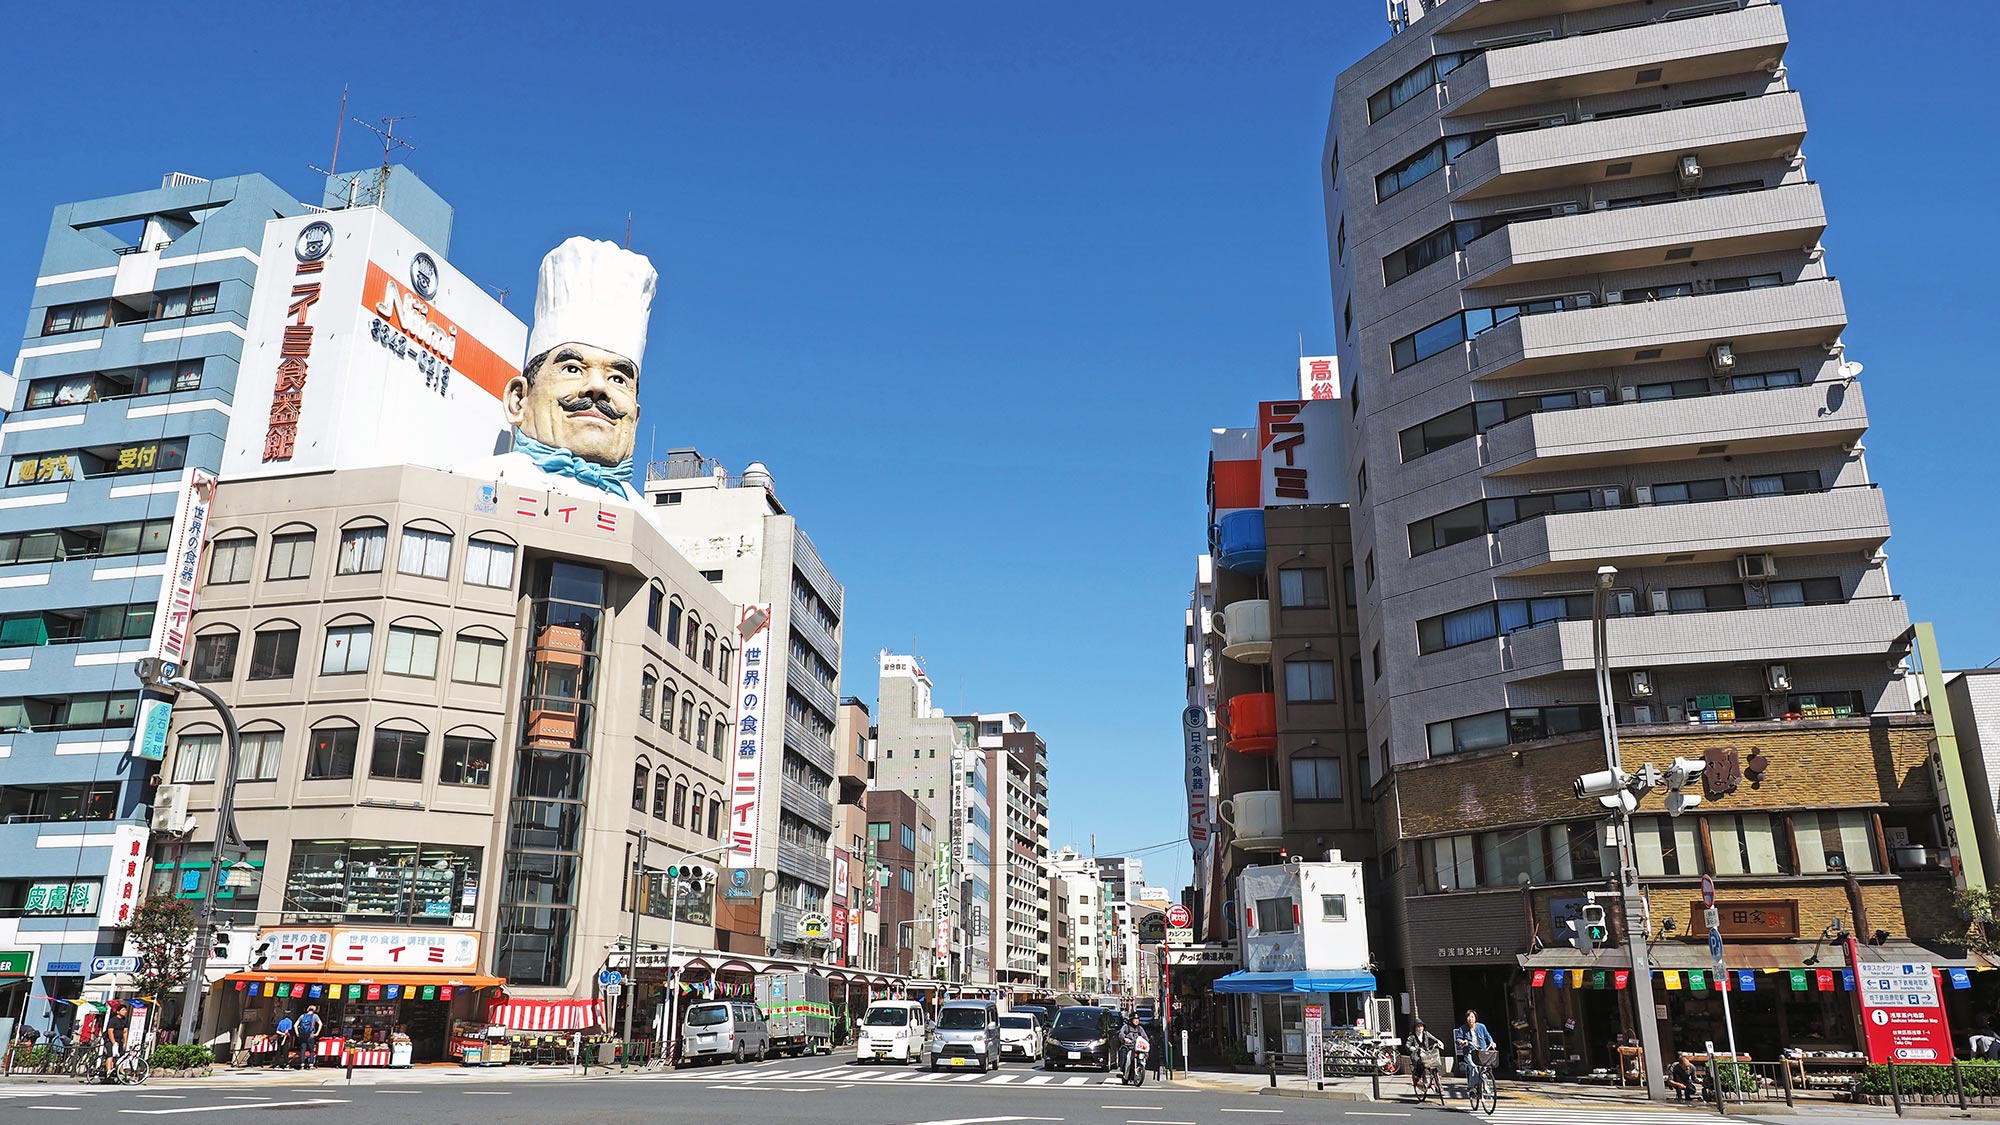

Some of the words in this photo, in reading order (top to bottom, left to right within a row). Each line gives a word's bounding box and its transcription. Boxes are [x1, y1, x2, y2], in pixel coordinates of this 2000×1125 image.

[376, 280, 457, 364] Niimi
[262, 261, 324, 463] ニイミ食器館
[117, 445, 157, 470] 受付
[1269, 403, 1309, 499] ニイミ
[516, 496, 617, 532] ニイミ
[178, 505, 204, 583] 世界の食器
[166, 587, 190, 652] ニイミ
[739, 647, 761, 757] 世界の食器
[1191, 731, 1204, 790] 日本の食器
[733, 772, 755, 854] ニイミ
[1191, 794, 1208, 841] ニイミ
[25, 884, 90, 910] 皮膚科
[279, 944, 325, 961] ニイミ
[282, 933, 327, 943] 世界の食器
[347, 945, 445, 963] ニイミ
